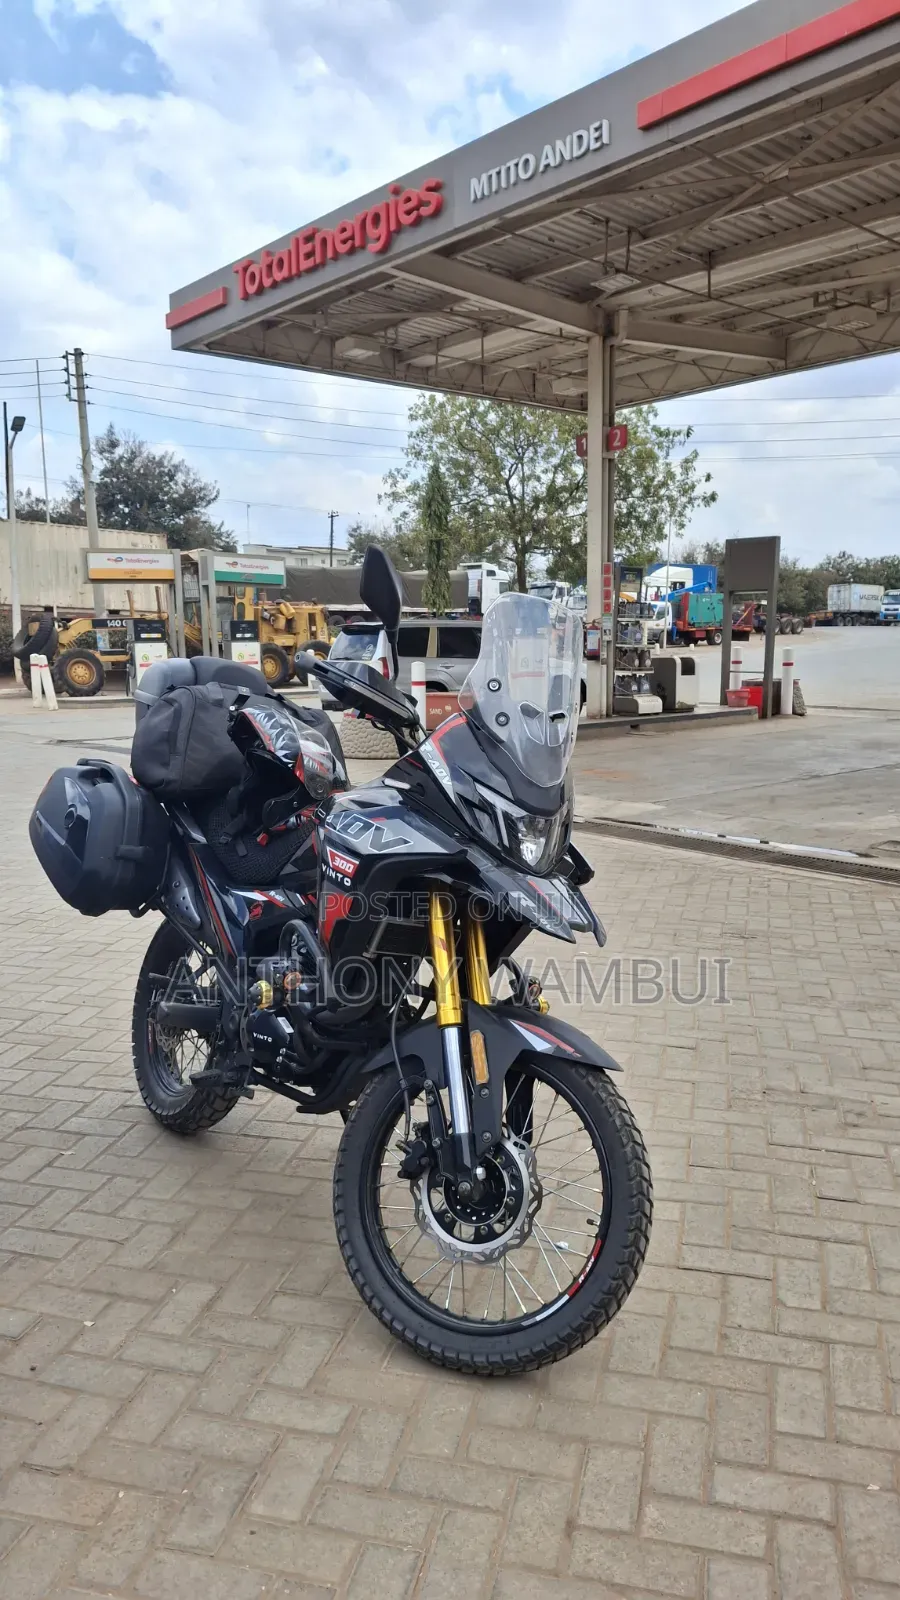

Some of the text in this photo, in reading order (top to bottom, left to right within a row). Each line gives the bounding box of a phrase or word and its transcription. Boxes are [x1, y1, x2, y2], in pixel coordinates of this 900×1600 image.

[470, 119, 611, 203] MTITO ANDEI
[233, 177, 444, 301] TotalEnergies
[581, 437, 587, 451] 1
[612, 429, 621, 447] 2
[107, 619, 121, 627] 140
[332, 856, 354, 873] 300
[321, 863, 352, 887] VINTO
[253, 1032, 273, 1043] VINTO
